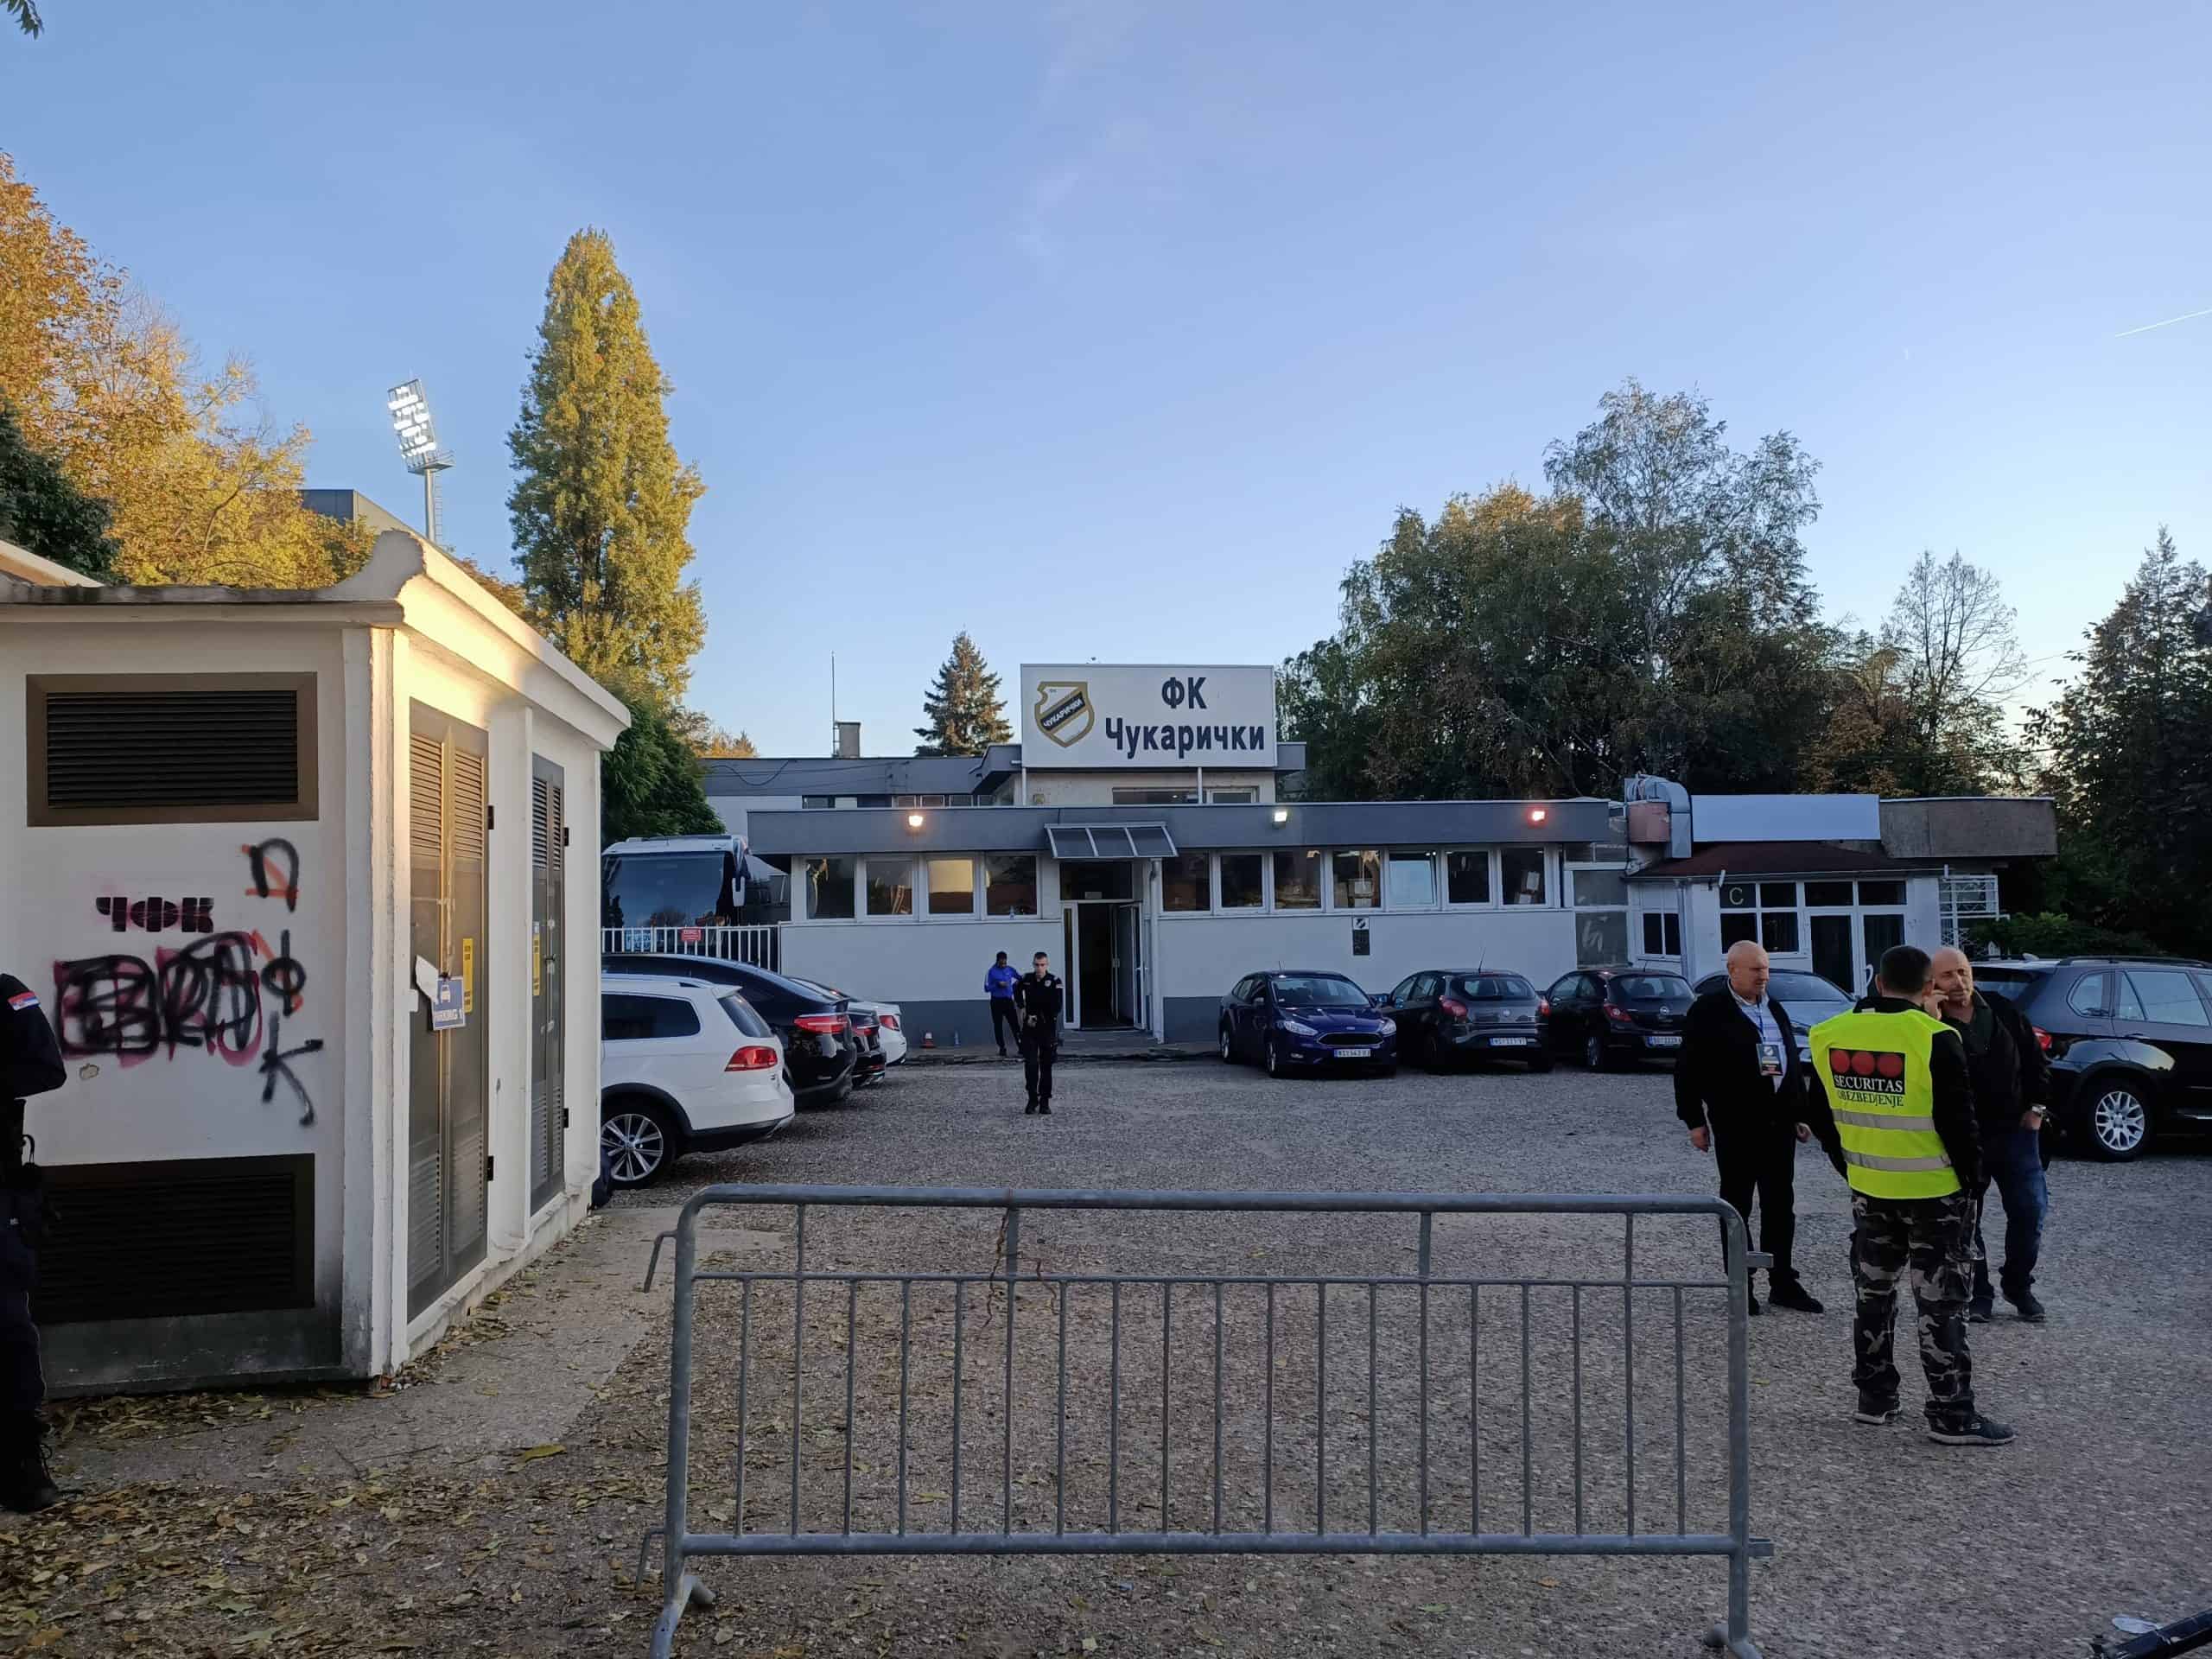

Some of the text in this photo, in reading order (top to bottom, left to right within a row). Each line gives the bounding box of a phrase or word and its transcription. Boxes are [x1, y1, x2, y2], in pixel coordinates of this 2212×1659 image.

[1161, 677, 1207, 709] ФК
[1105, 717, 1265, 759] Чукарички
[1834, 1074, 1904, 1093] SECURITAS
